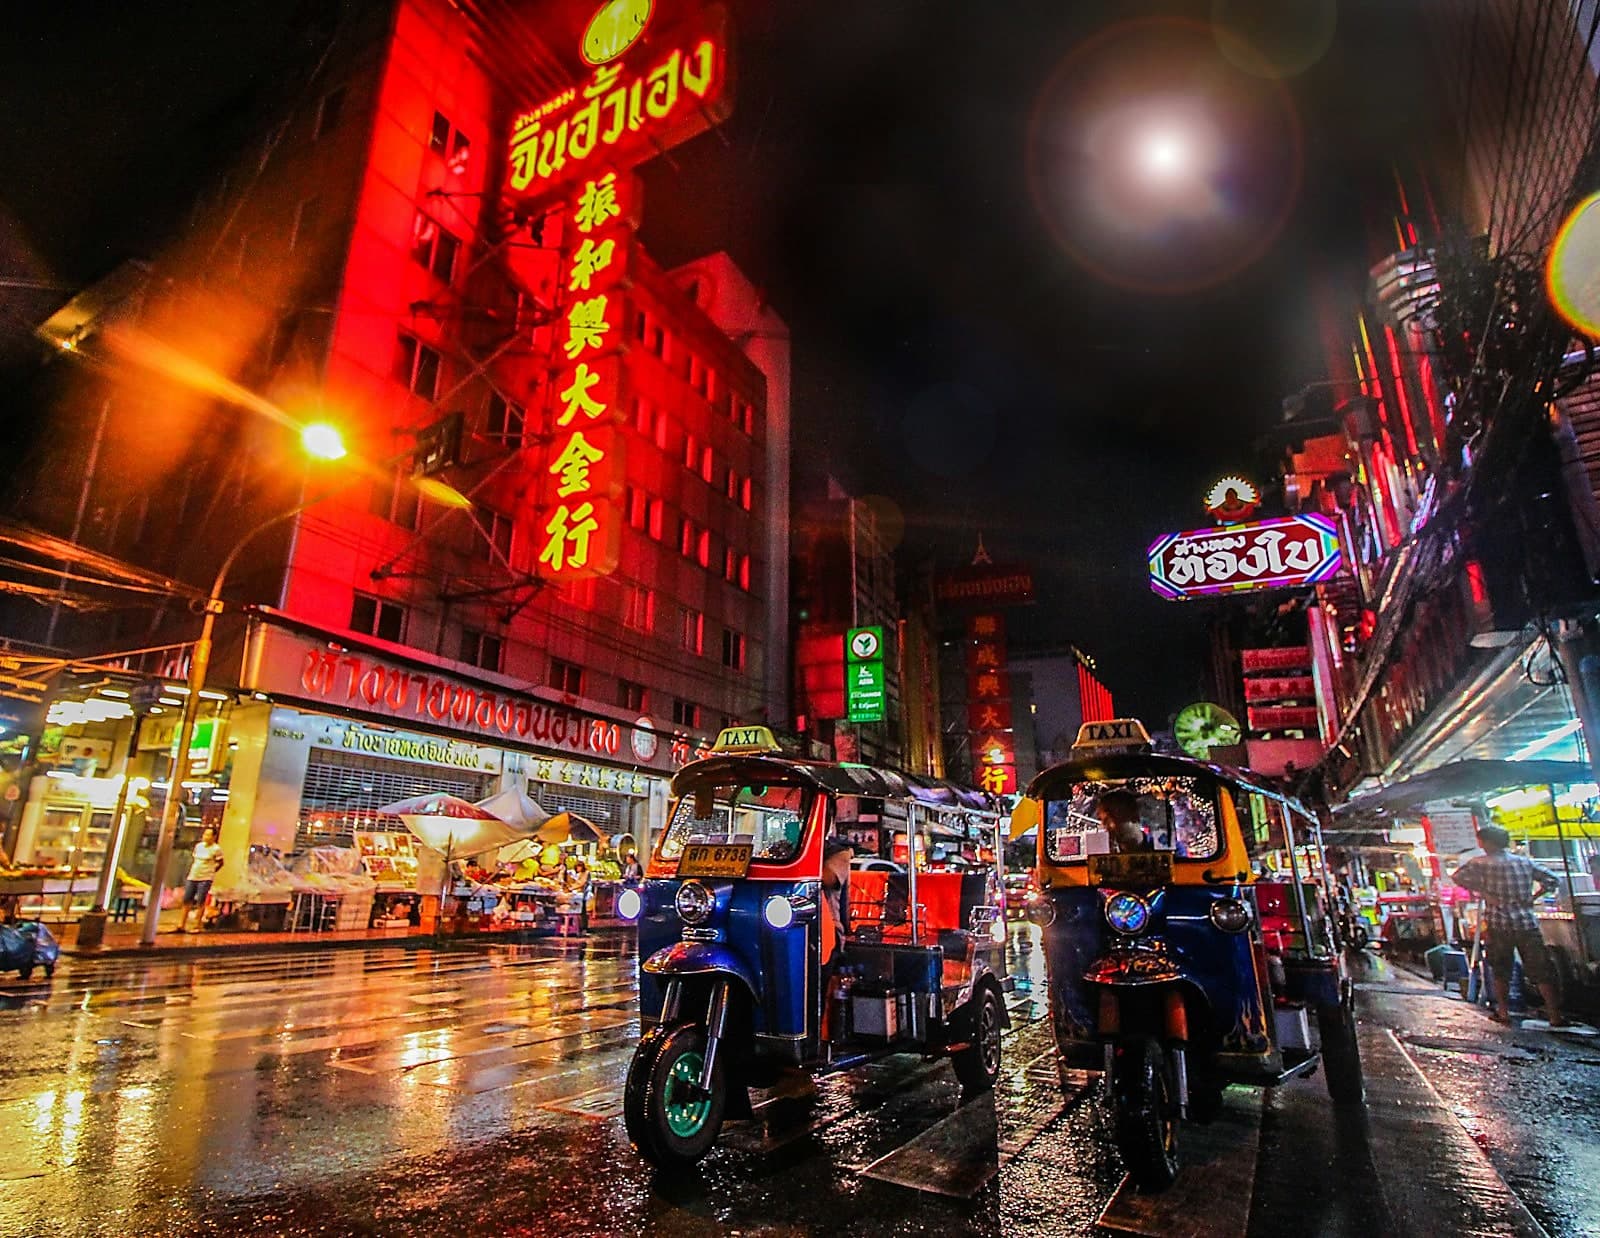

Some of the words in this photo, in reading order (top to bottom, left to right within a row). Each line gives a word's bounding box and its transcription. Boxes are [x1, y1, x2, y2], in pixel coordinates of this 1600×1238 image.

[539, 172, 621, 571] 振和興大金行
[723, 729, 760, 747] TAXI
[1085, 723, 1133, 740] TAXI
[713, 847, 748, 862] 6738
